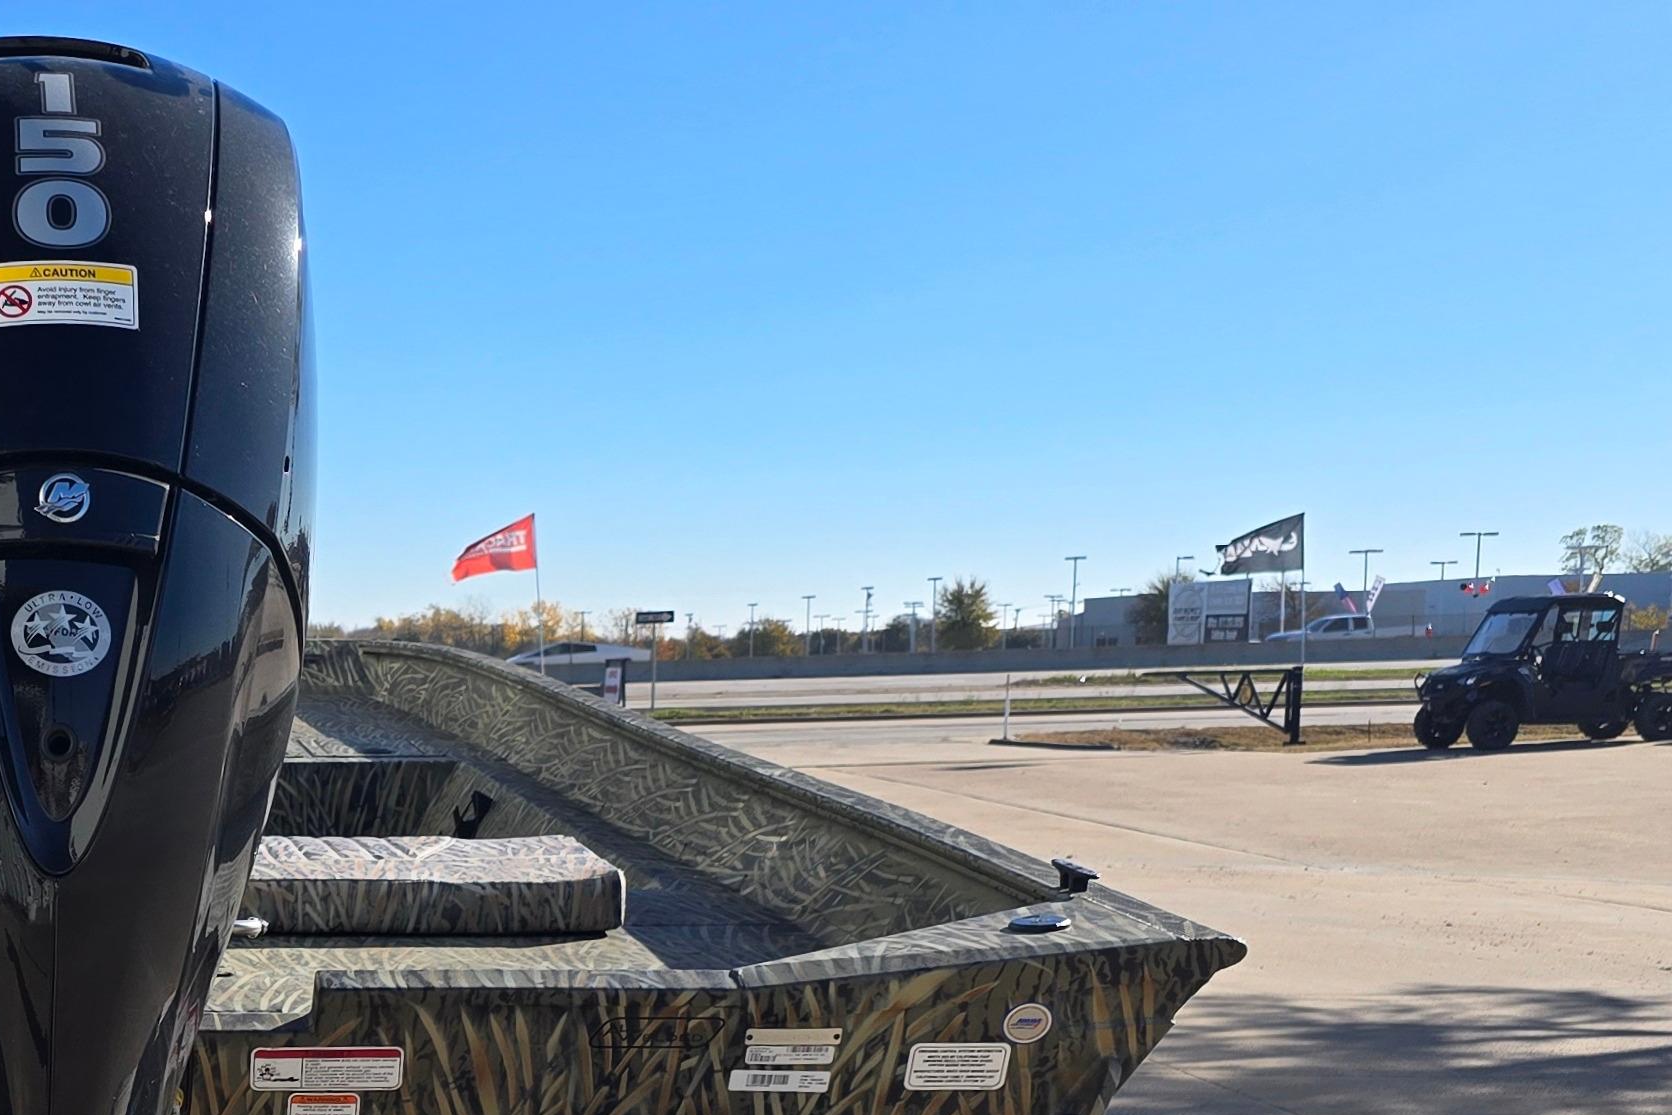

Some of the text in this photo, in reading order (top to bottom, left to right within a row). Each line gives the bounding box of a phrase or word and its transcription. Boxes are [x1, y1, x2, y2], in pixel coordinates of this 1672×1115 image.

[12, 71, 112, 250] 150
[42, 268, 96, 278] CAUTION
[96, 288, 116, 296] finger
[103, 295, 126, 303] fingers
[24, 592, 103, 619] ULTRA LOW
